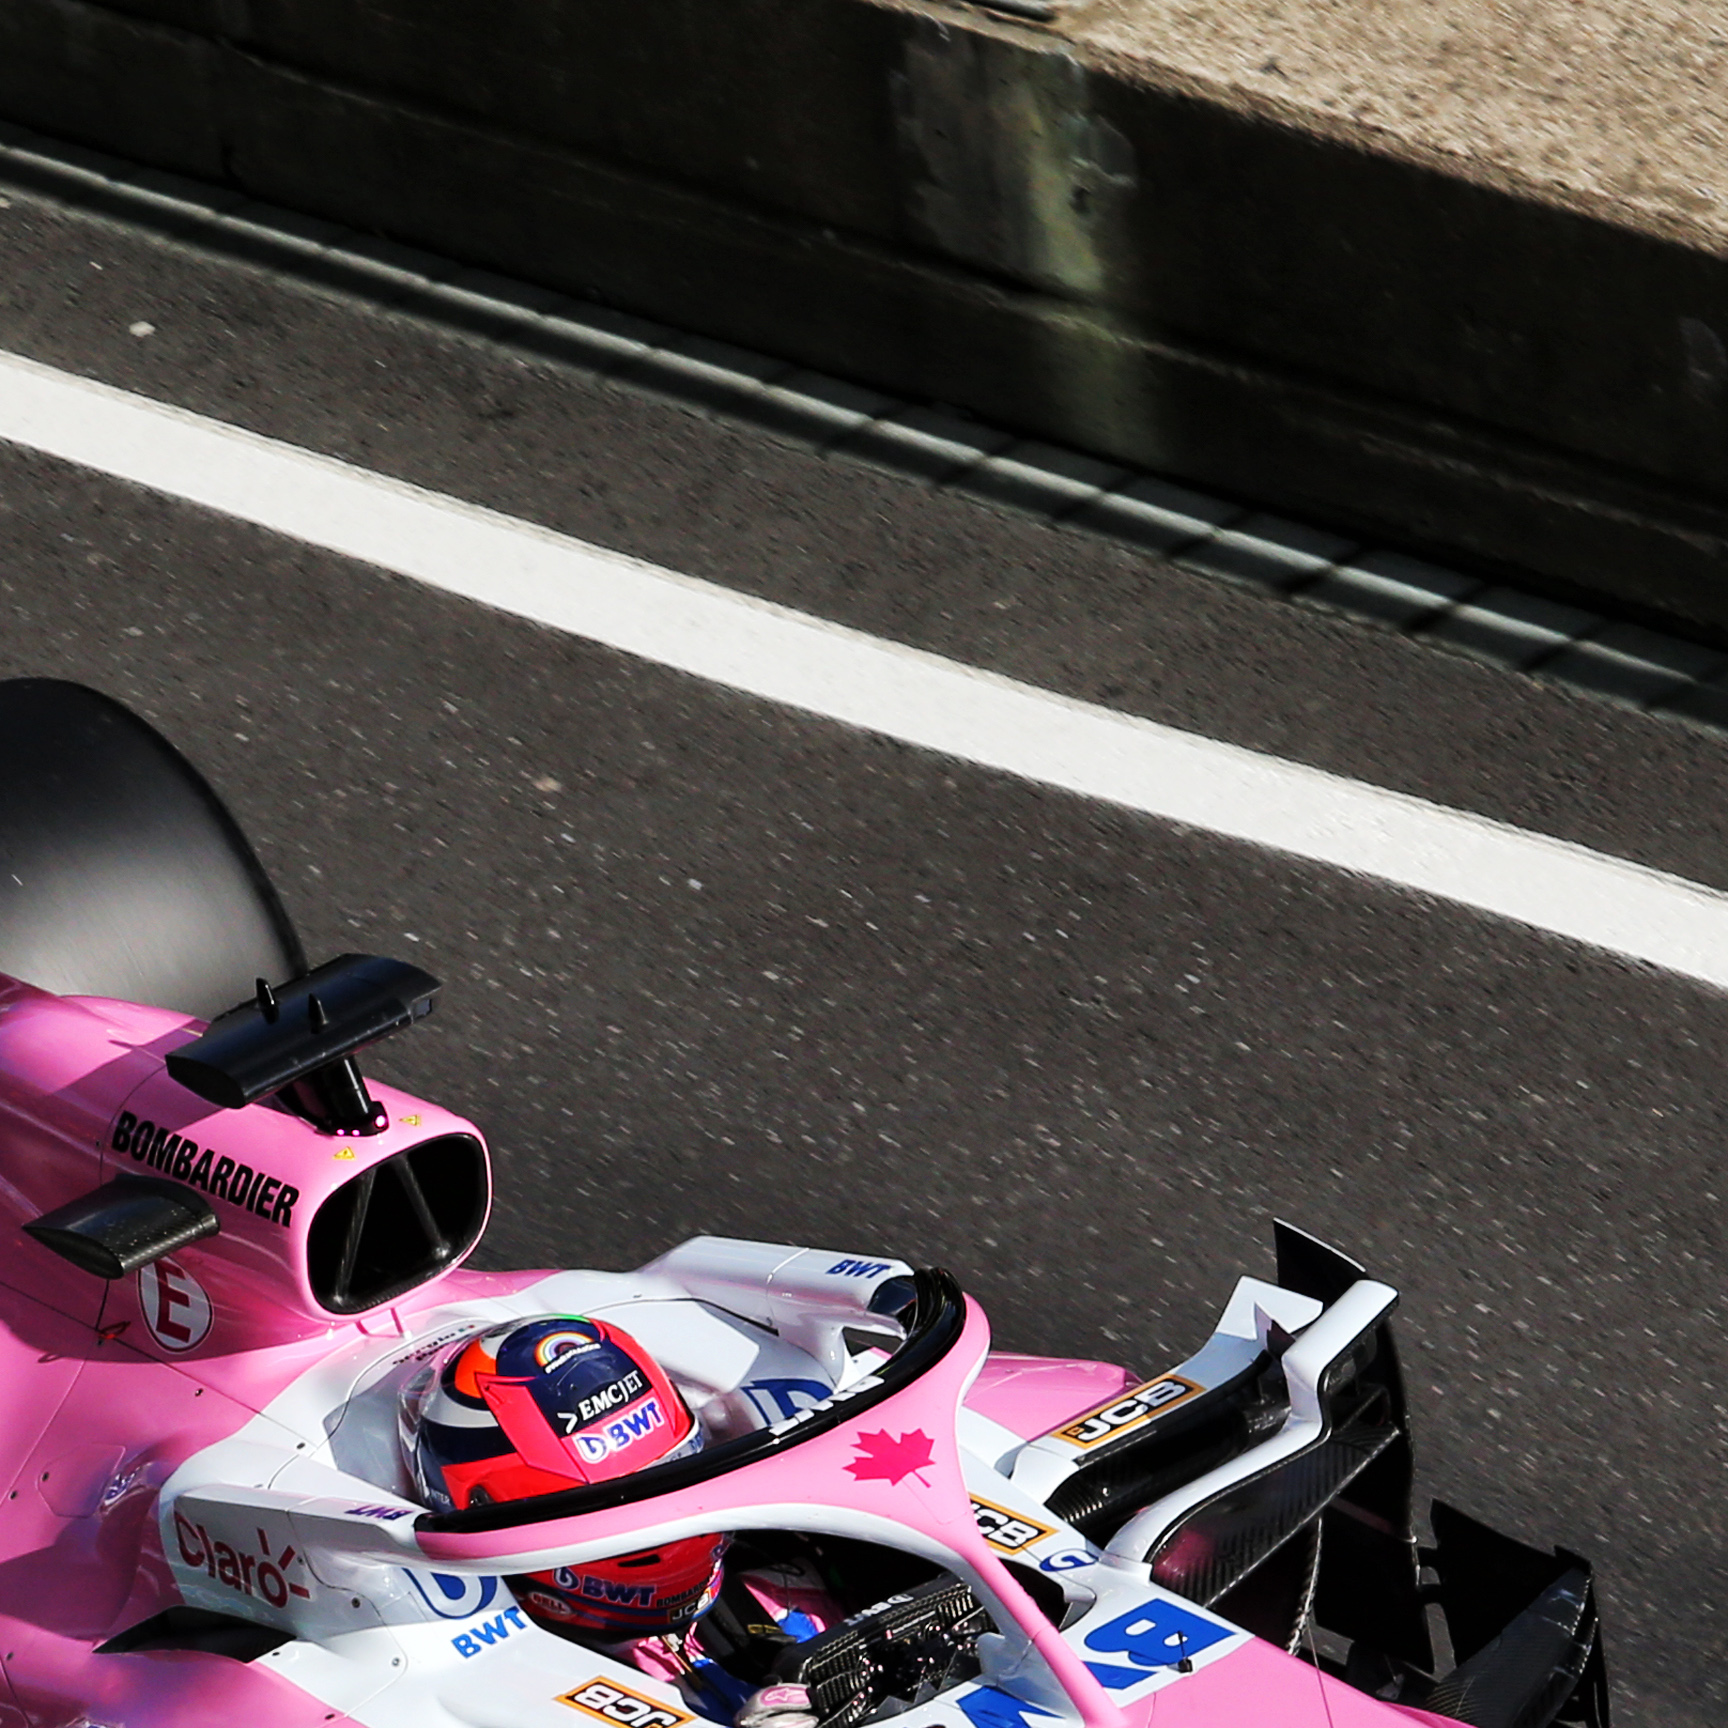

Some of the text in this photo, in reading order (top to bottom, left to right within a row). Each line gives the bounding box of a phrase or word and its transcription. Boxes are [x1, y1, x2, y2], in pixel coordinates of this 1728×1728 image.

[111, 1111, 300, 1227] BOMBARDIER
[825, 1259, 891, 1278] BWT
[578, 1370, 644, 1421] EMCJET
[1076, 1378, 1187, 1443] JCB
[606, 1398, 665, 1449] BWT
[971, 1503, 1039, 1547] CB
[175, 1513, 310, 1608] Claro
[582, 1575, 656, 1606] BWT
[672, 1591, 710, 1620] JCB
[451, 1605, 529, 1660] BWT
